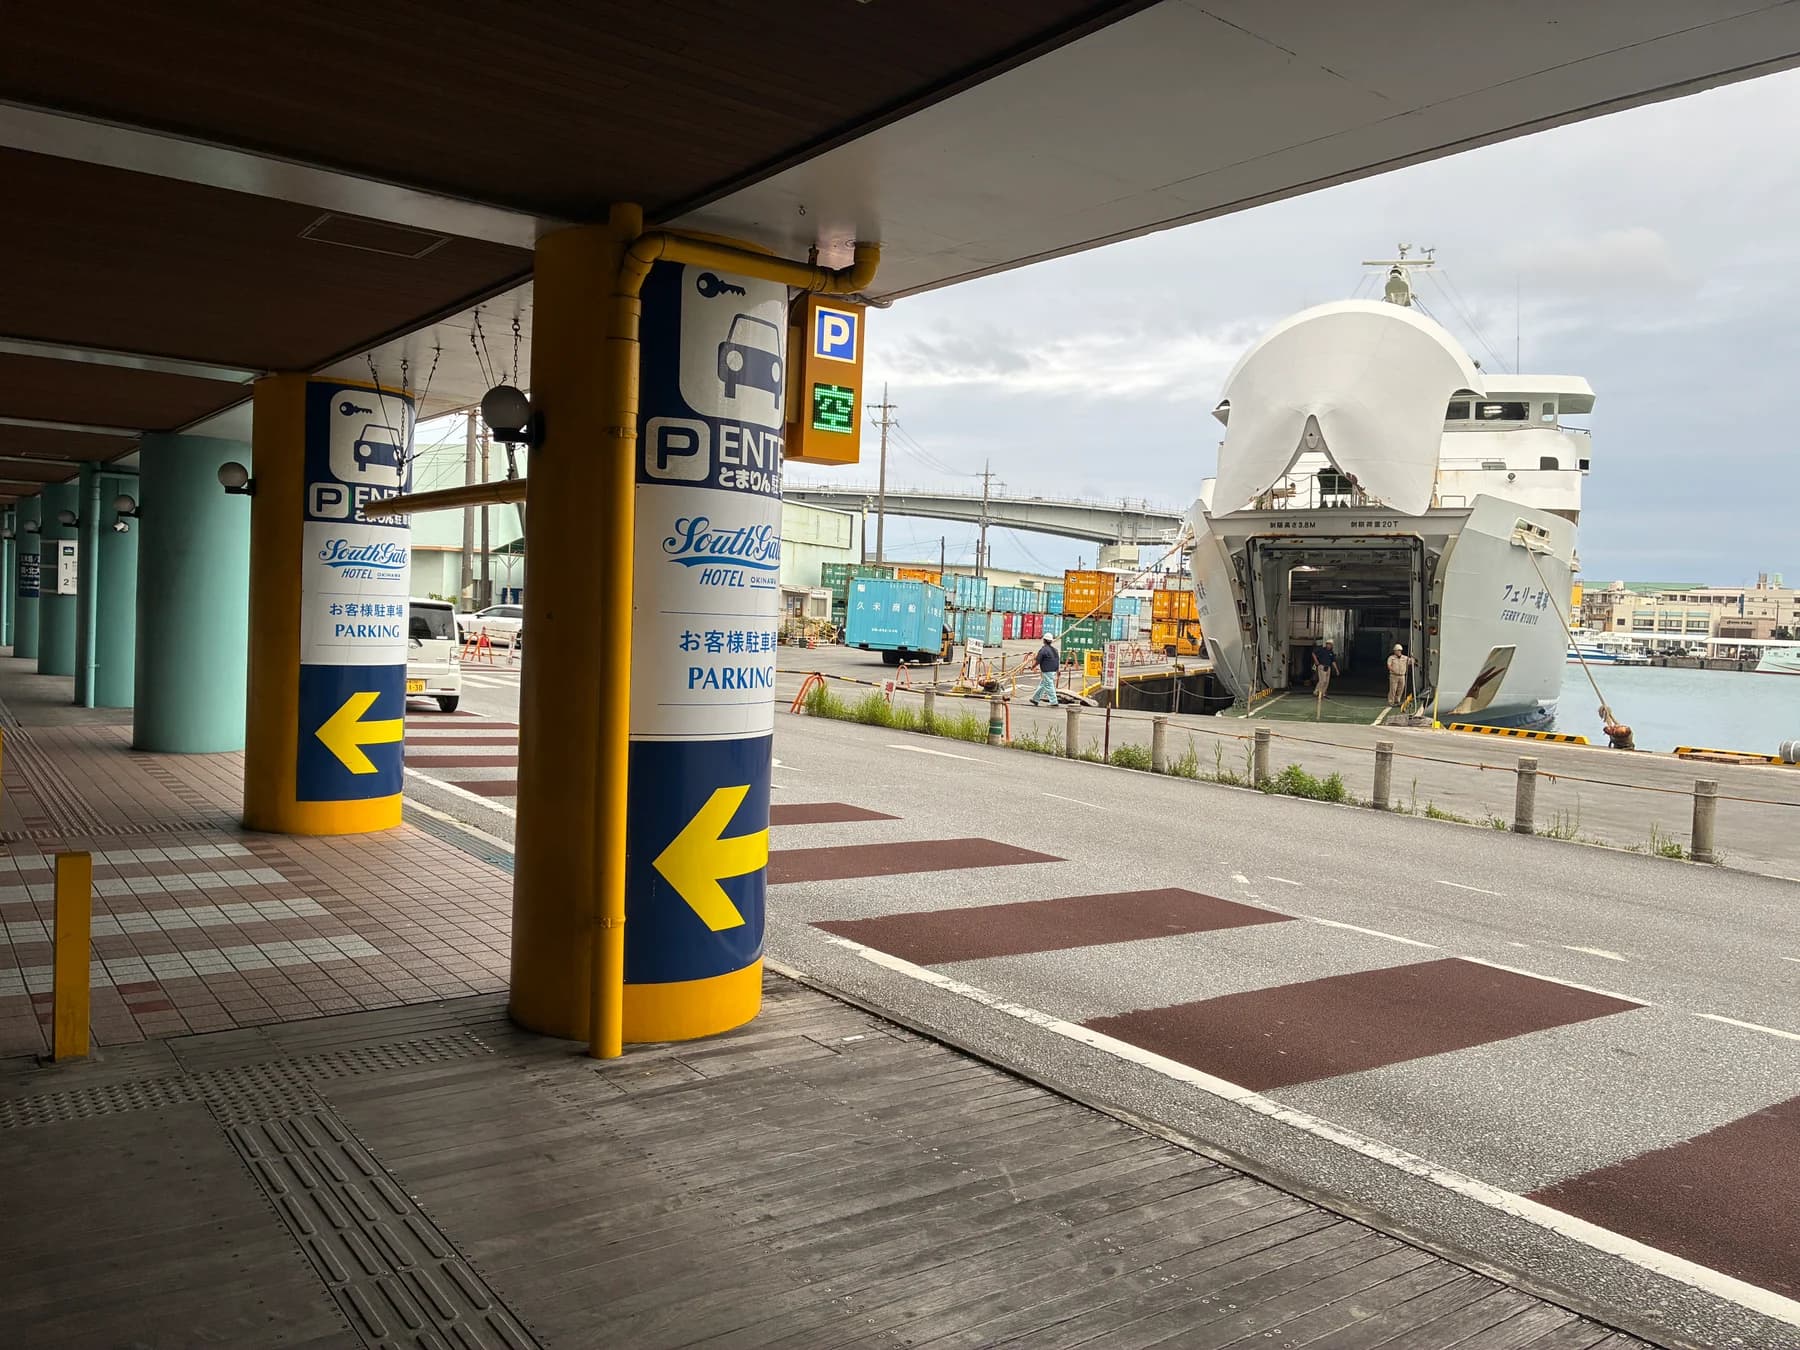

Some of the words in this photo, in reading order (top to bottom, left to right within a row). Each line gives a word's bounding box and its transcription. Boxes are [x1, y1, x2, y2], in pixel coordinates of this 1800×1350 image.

[823, 314, 850, 353] P
[813, 384, 854, 434] 空
[656, 425, 699, 470] P
[316, 487, 342, 512] P
[63, 562, 69, 570] 1
[341, 568, 373, 580] HOTEL
[63, 578, 70, 586] 2
[699, 568, 745, 588] HOTEL
[335, 623, 400, 638] PARKING
[688, 665, 774, 690] PARKING
